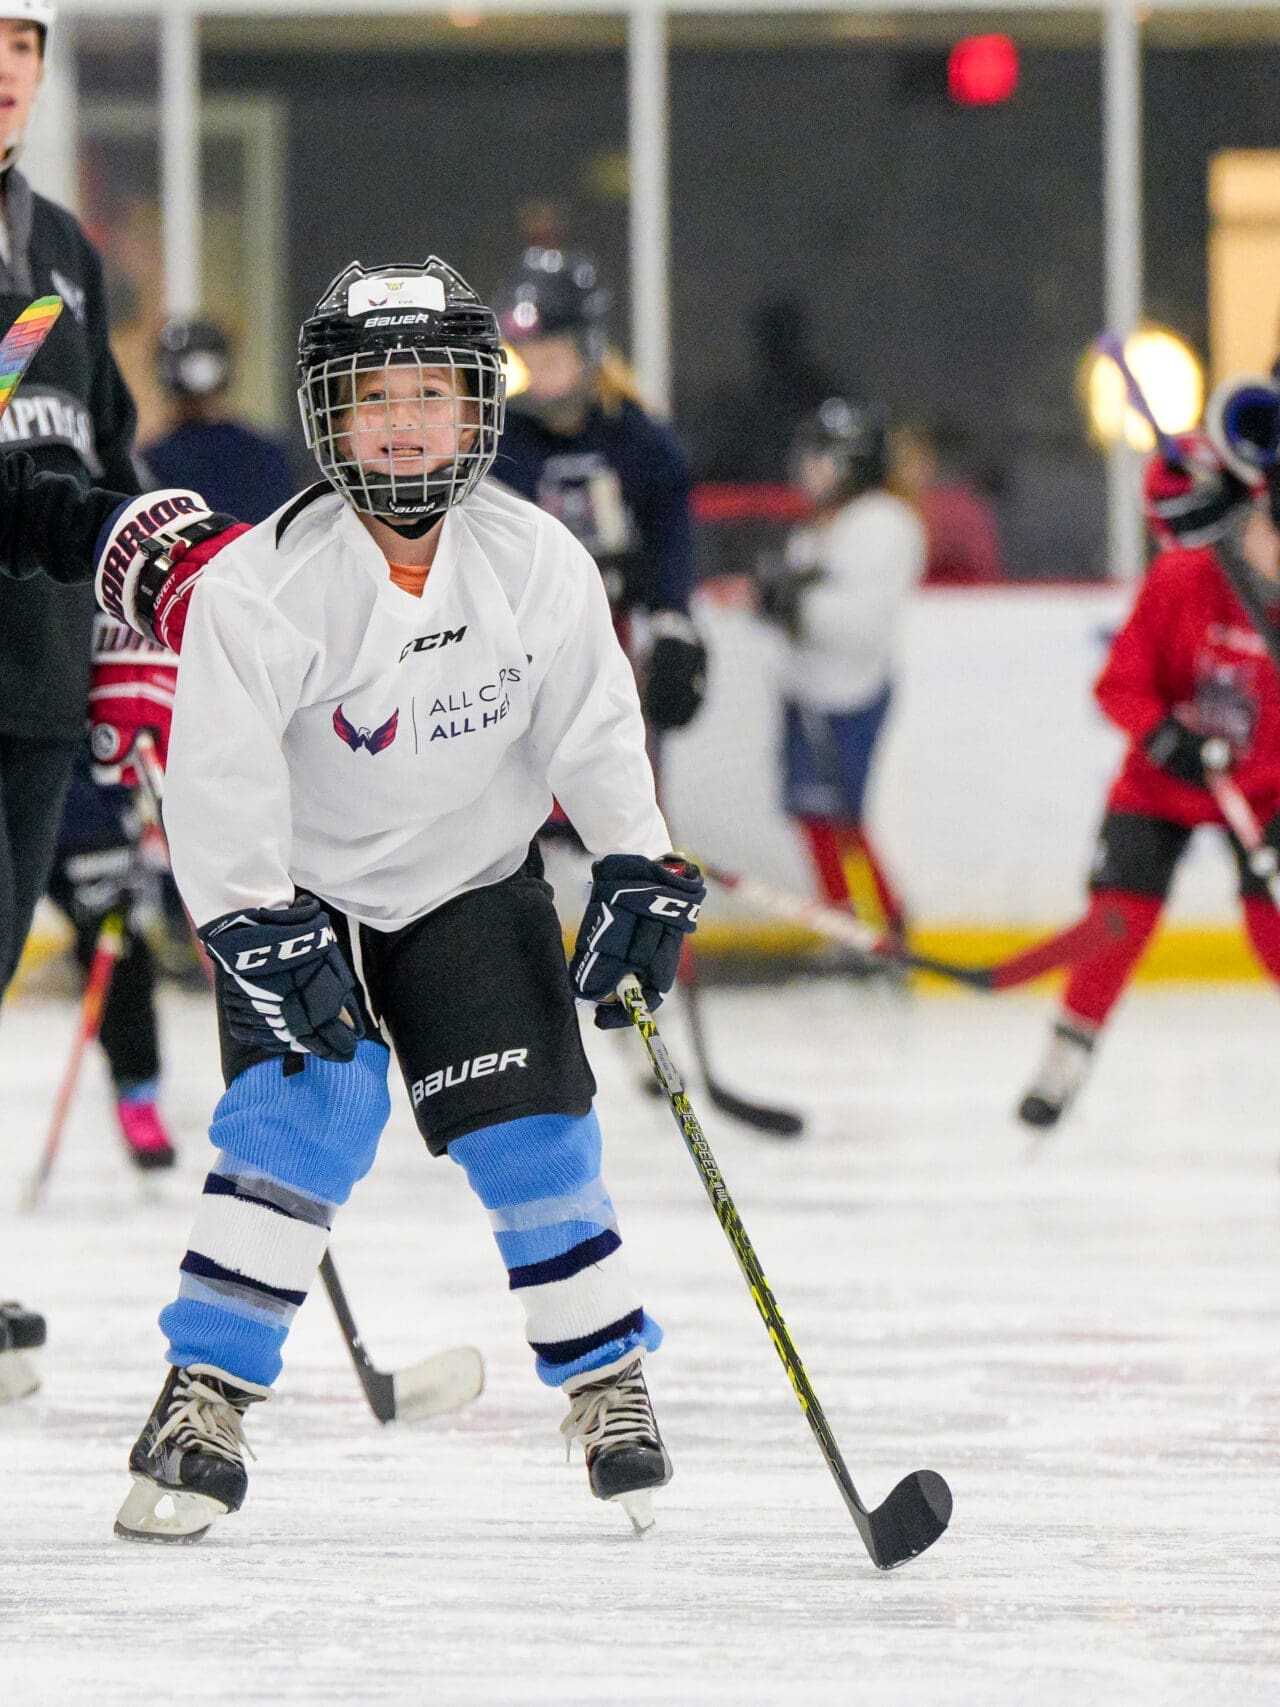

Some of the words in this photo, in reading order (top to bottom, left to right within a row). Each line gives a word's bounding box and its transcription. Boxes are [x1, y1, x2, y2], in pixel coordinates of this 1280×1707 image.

[429, 691, 473, 716] ALL
[479, 668, 521, 702] CPS
[430, 717, 476, 742] ALL
[411, 1048, 528, 1109] BAUER
